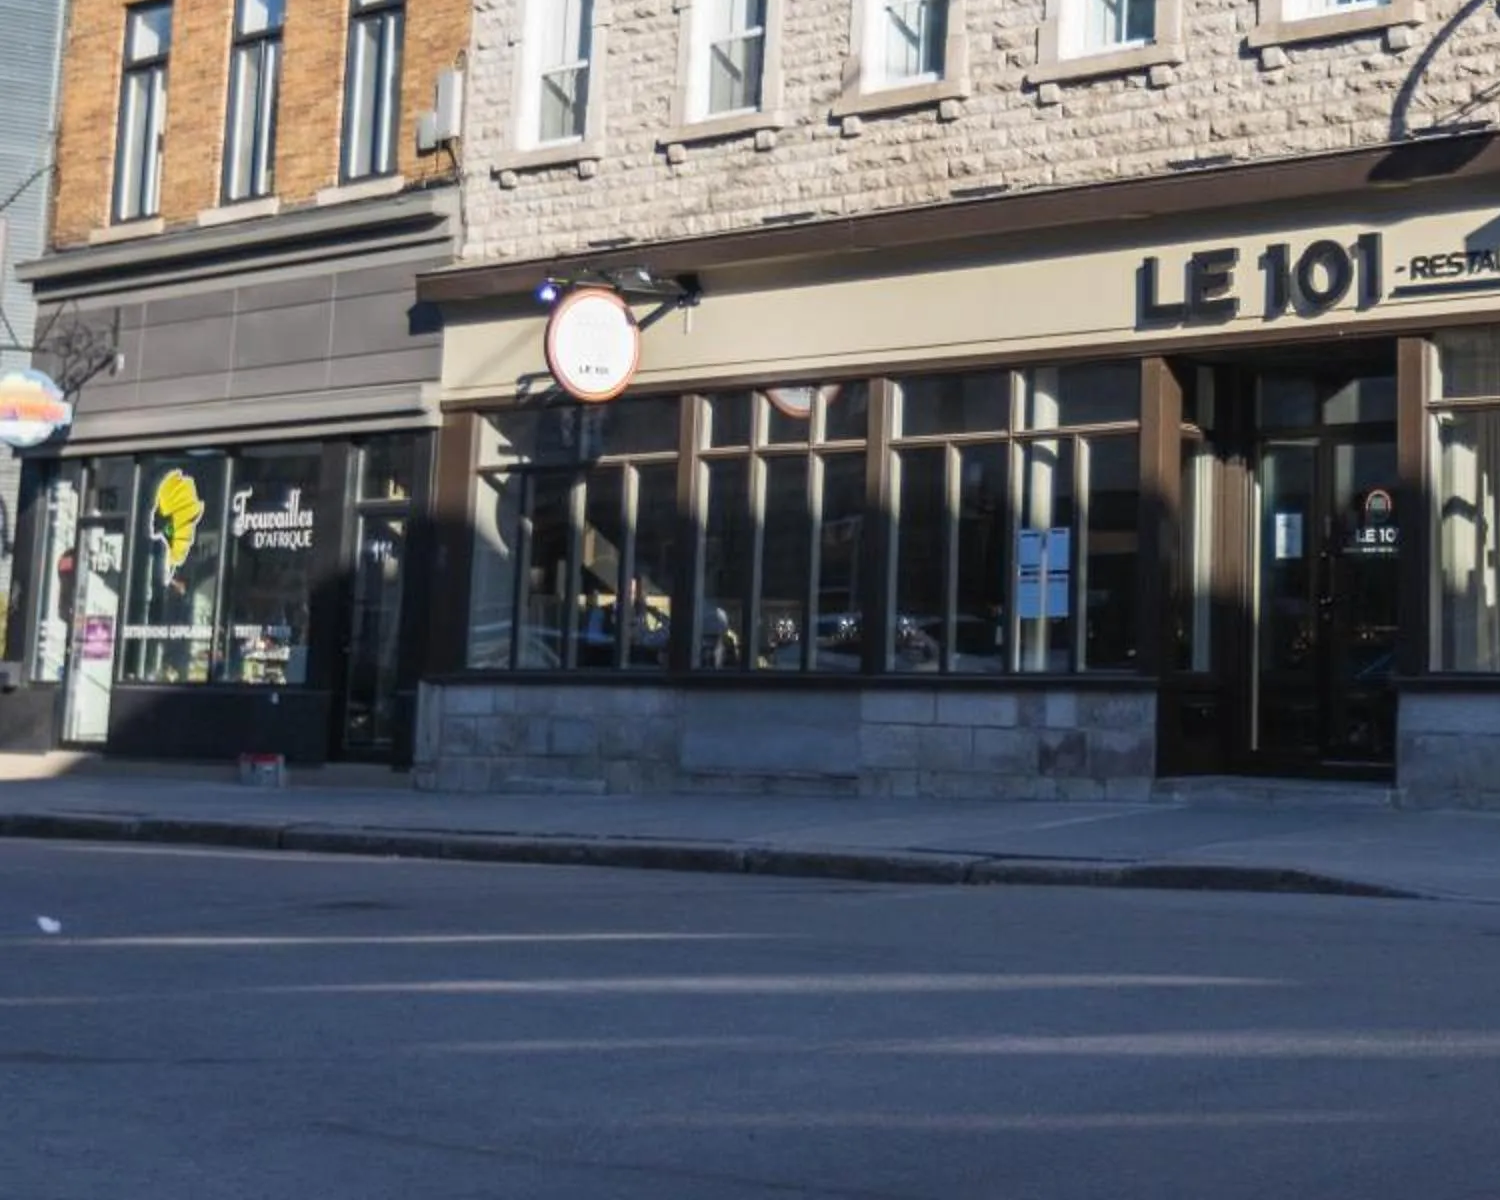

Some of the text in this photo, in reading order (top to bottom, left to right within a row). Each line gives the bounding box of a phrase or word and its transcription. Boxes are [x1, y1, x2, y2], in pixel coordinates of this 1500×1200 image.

[1135, 232, 1382, 330] LE 101
[254, 529, 314, 551] D'AFRIQUE
